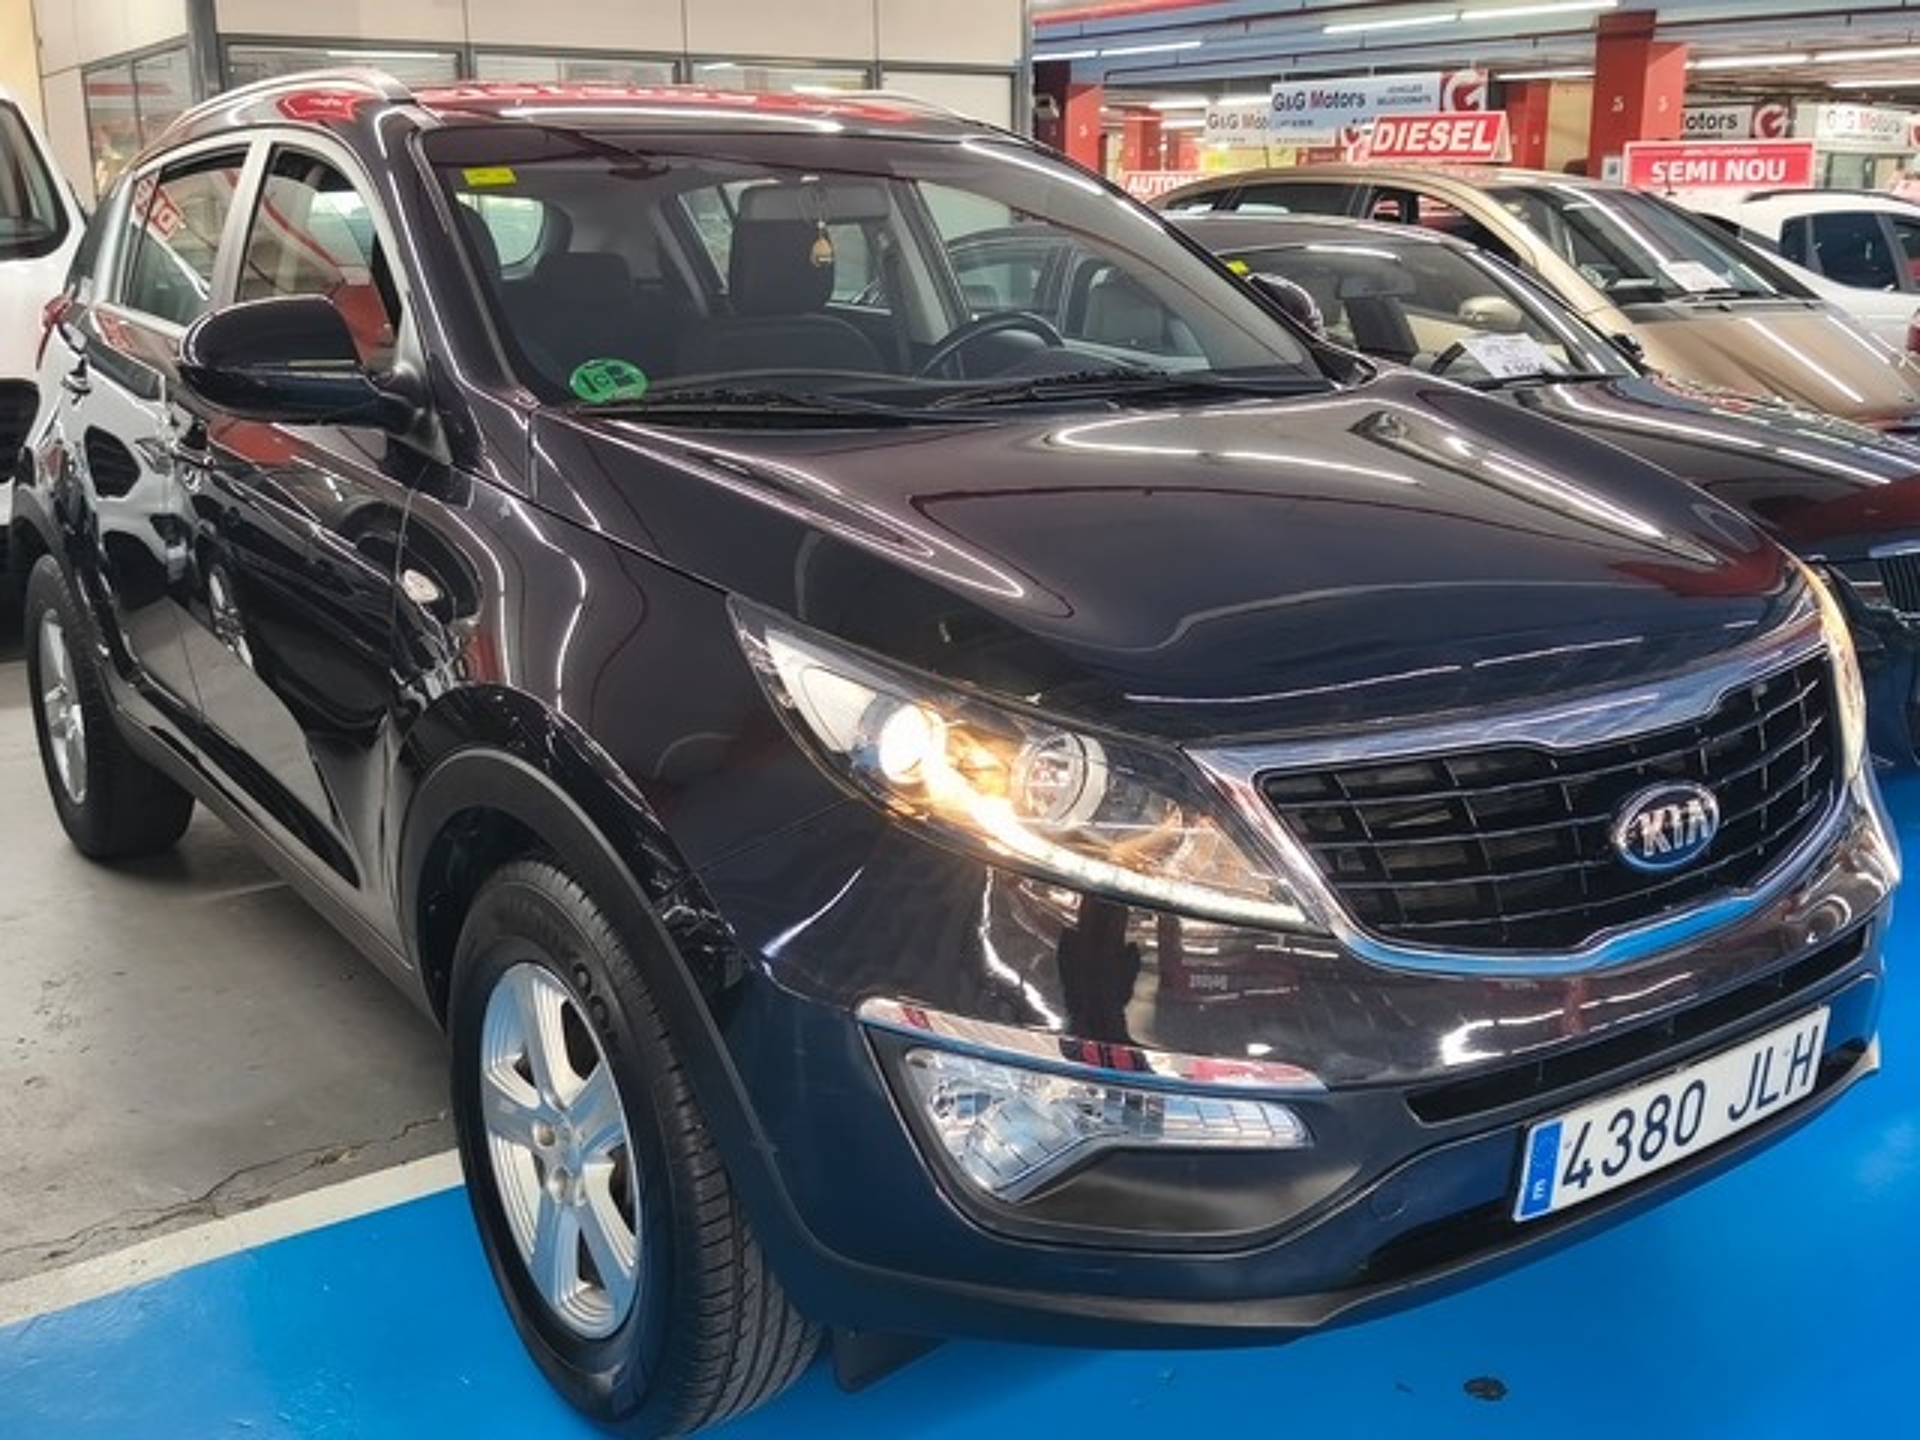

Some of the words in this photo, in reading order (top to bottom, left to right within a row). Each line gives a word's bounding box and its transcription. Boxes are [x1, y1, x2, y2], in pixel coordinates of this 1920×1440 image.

[1310, 90, 1366, 109] Motors
[1682, 112, 1738, 130] otors
[1374, 119, 1494, 152] DIESEL
[1651, 161, 1717, 182] SEMI
[1724, 159, 1786, 180] NOU
[1639, 800, 1711, 857] KIA
[1562, 1078, 1706, 1190] 4380
[1728, 1024, 1820, 1122] JLH
[1533, 1177, 1545, 1200] E
